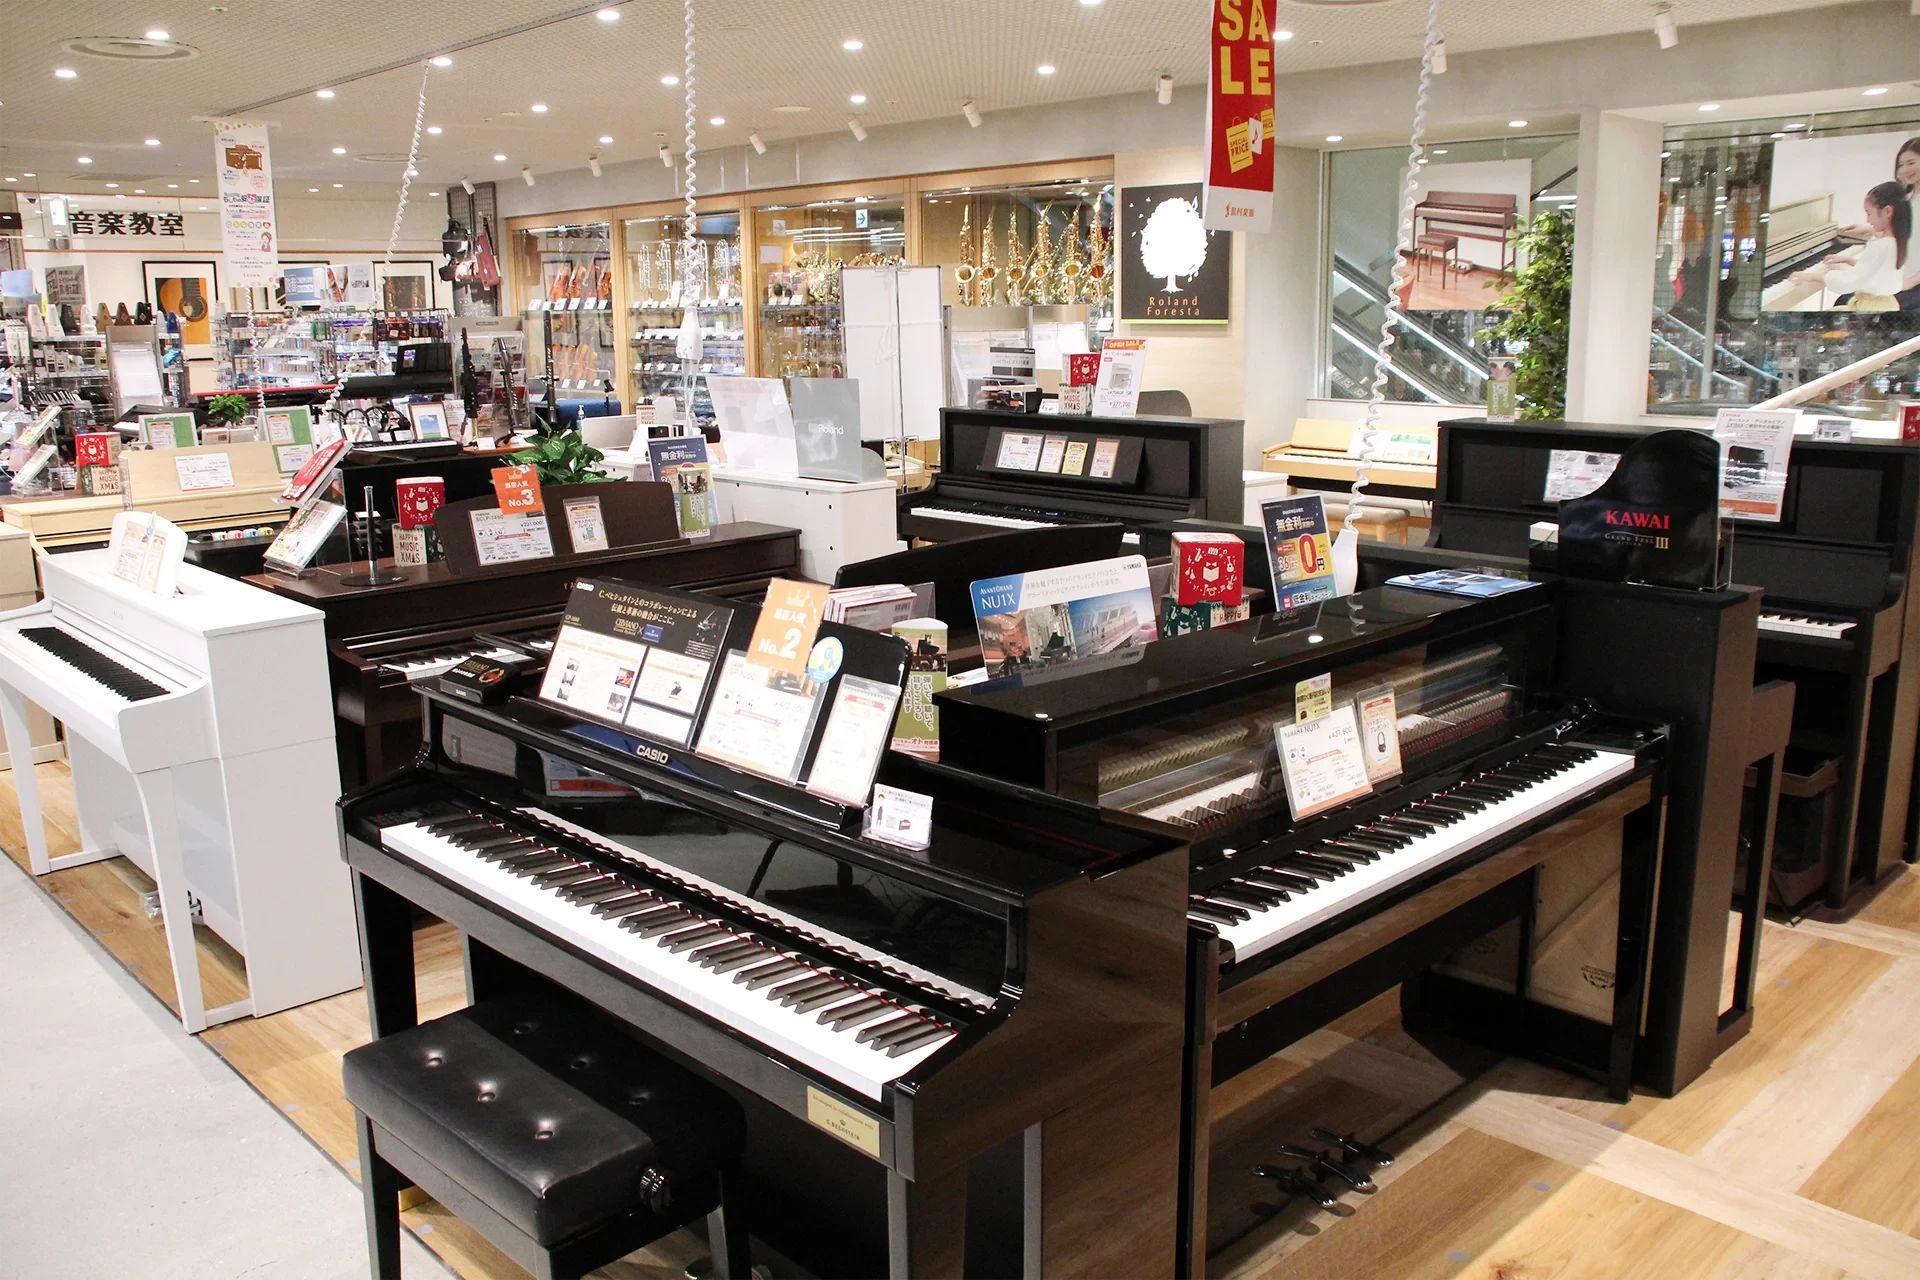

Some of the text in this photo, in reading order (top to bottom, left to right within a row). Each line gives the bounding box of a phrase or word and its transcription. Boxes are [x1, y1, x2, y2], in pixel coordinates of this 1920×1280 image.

[1220, 46, 1272, 96] LE
[1230, 137, 1248, 147] SPECIAL
[1231, 142, 1249, 157] PRICE
[69, 211, 184, 236] 音楽教室
[1149, 296, 1199, 306] Roland
[1147, 306, 1200, 316] Foresta
[1109, 340, 1125, 348] OPEN
[817, 423, 844, 435] Roland
[661, 450, 685, 461] 無金利
[1275, 516, 1302, 533] 無金利
[1605, 509, 1671, 530] KAWAI
[399, 541, 420, 552] MUSIC
[1604, 532, 1631, 542] GRAND
[1655, 536, 1670, 550] III
[576, 582, 595, 592] CASIO
[982, 593, 1016, 610] NU1X
[636, 744, 669, 764] CASIO
